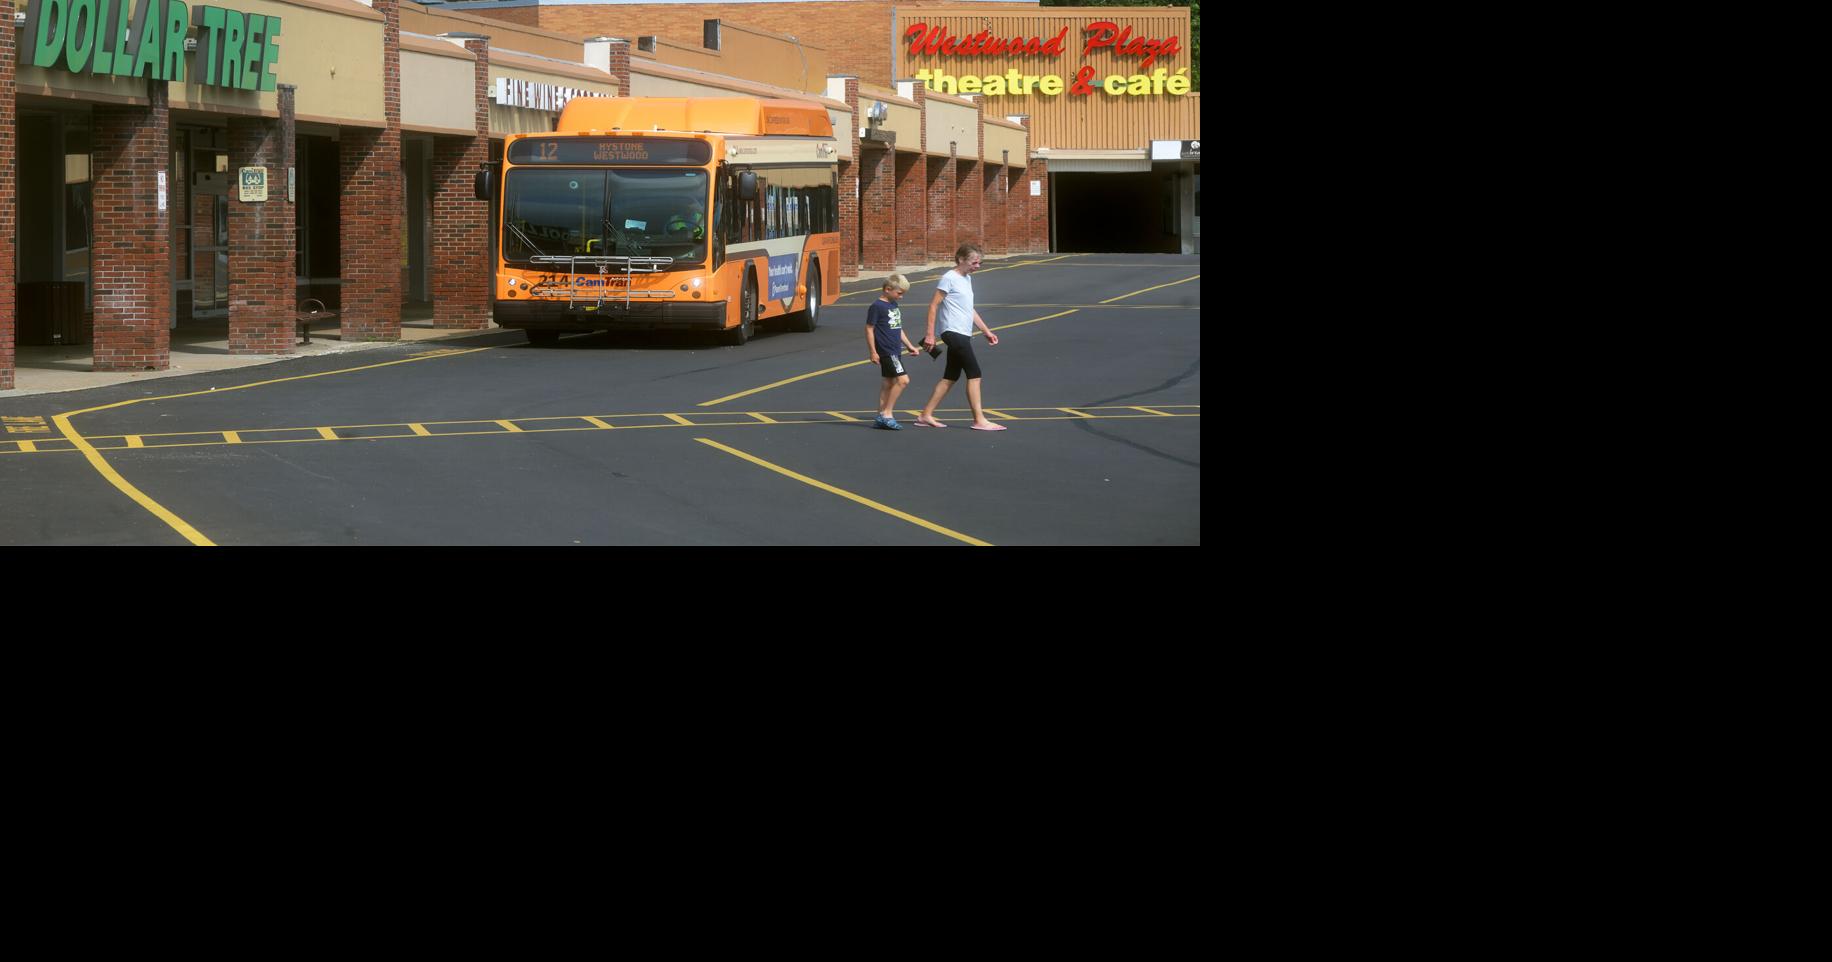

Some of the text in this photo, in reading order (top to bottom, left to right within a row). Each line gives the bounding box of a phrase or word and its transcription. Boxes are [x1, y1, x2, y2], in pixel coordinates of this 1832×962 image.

[33, 0, 281, 91] DOLLAR TREE
[905, 21, 1182, 69] Westwood Plaza
[506, 78, 529, 107] FINE
[533, 82, 559, 112] WINE
[915, 65, 1191, 96] theatre & café
[539, 143, 558, 160] 12
[593, 151, 649, 160] WESTWOOD
[575, 275, 632, 288] CamTran
